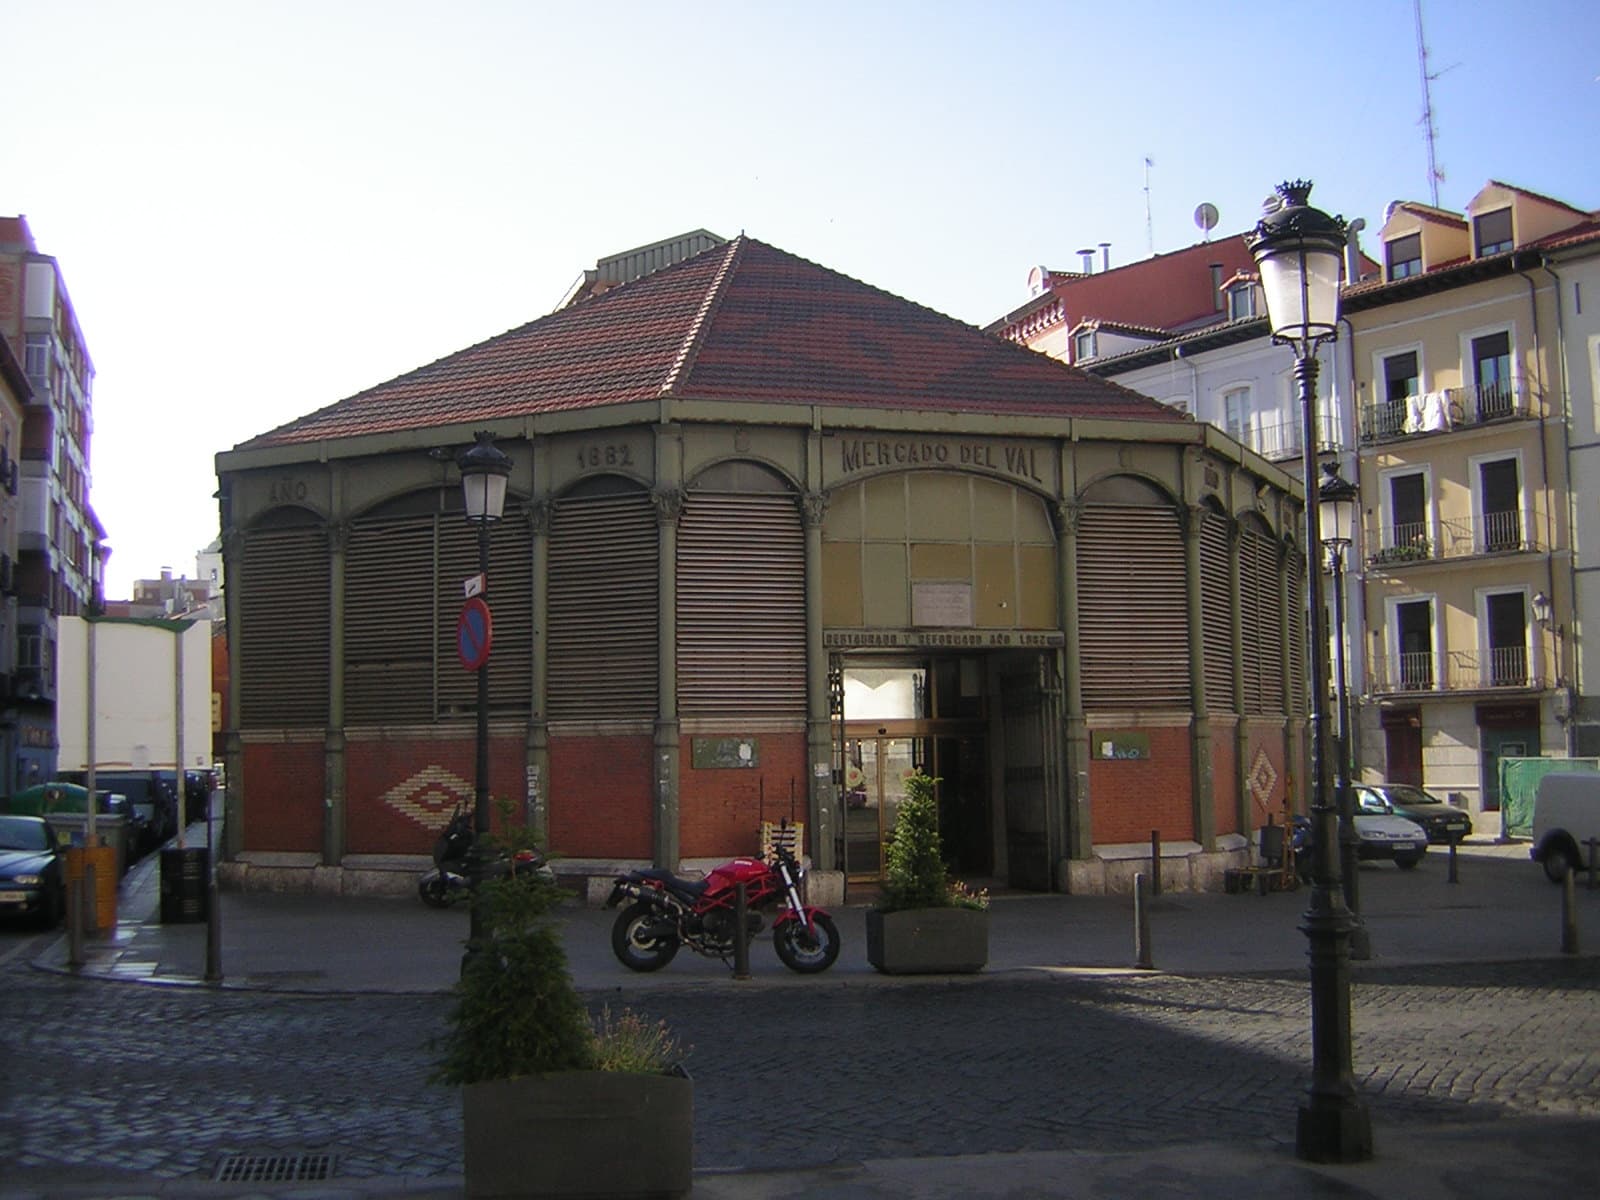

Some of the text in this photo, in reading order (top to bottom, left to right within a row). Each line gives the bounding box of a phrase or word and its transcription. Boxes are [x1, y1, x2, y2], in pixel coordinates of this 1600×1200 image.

[577, 444, 633, 469] 1882
[841, 438, 1042, 484] MERCADO DEL VAL
